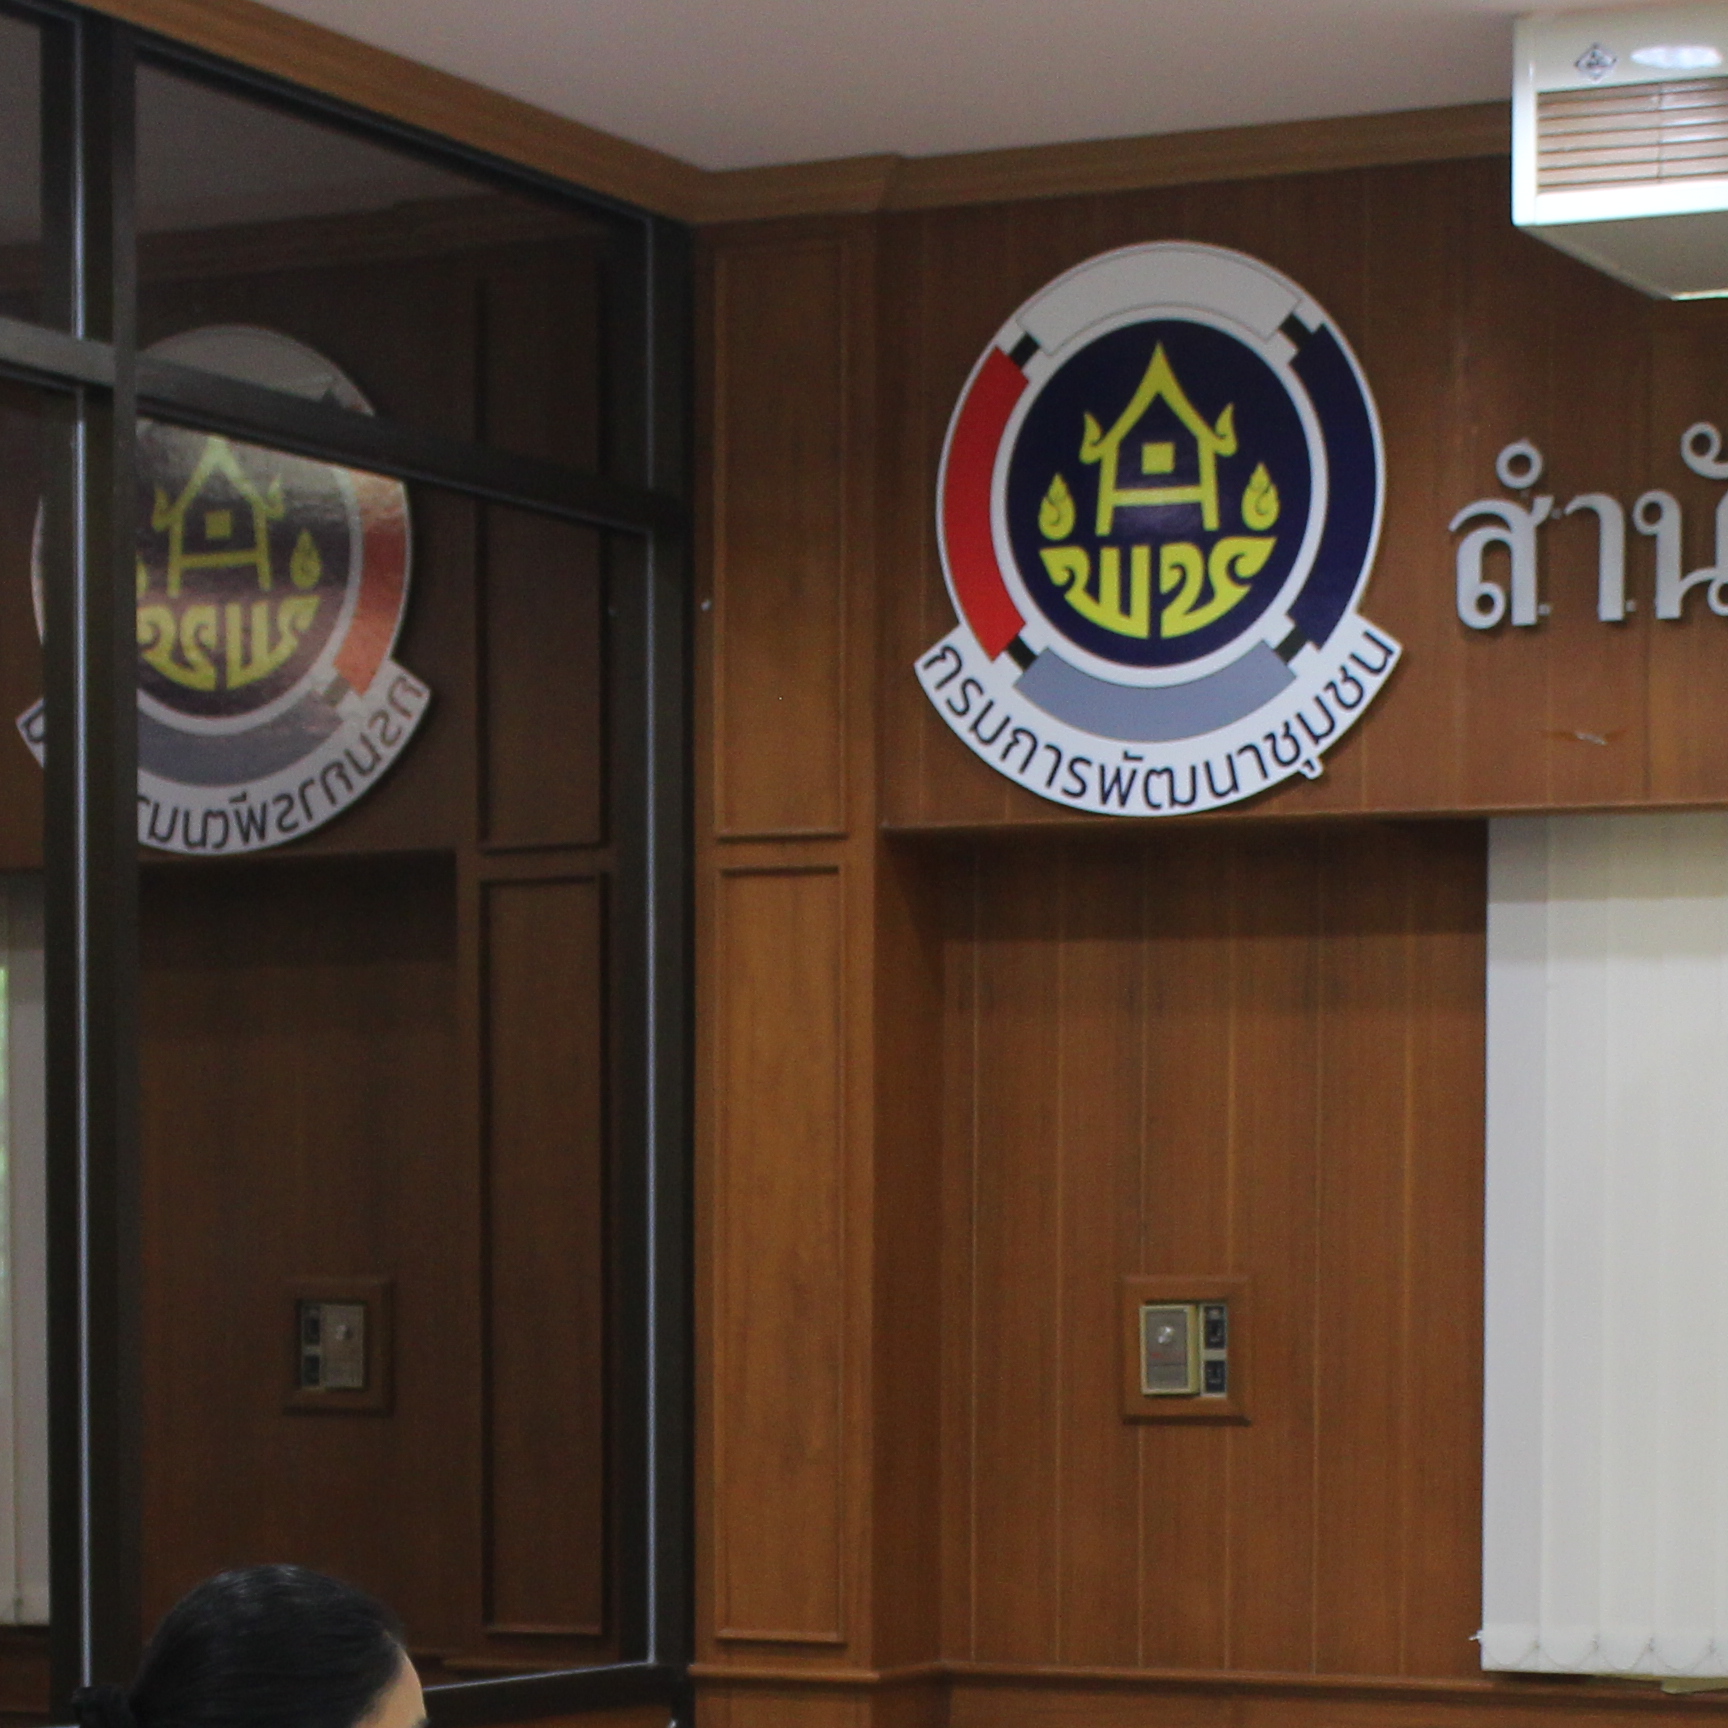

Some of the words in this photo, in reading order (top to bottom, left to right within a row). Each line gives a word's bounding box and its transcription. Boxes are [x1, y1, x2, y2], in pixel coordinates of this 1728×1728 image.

[923, 630, 1395, 809] กรมการพัฒนาชุมชน
